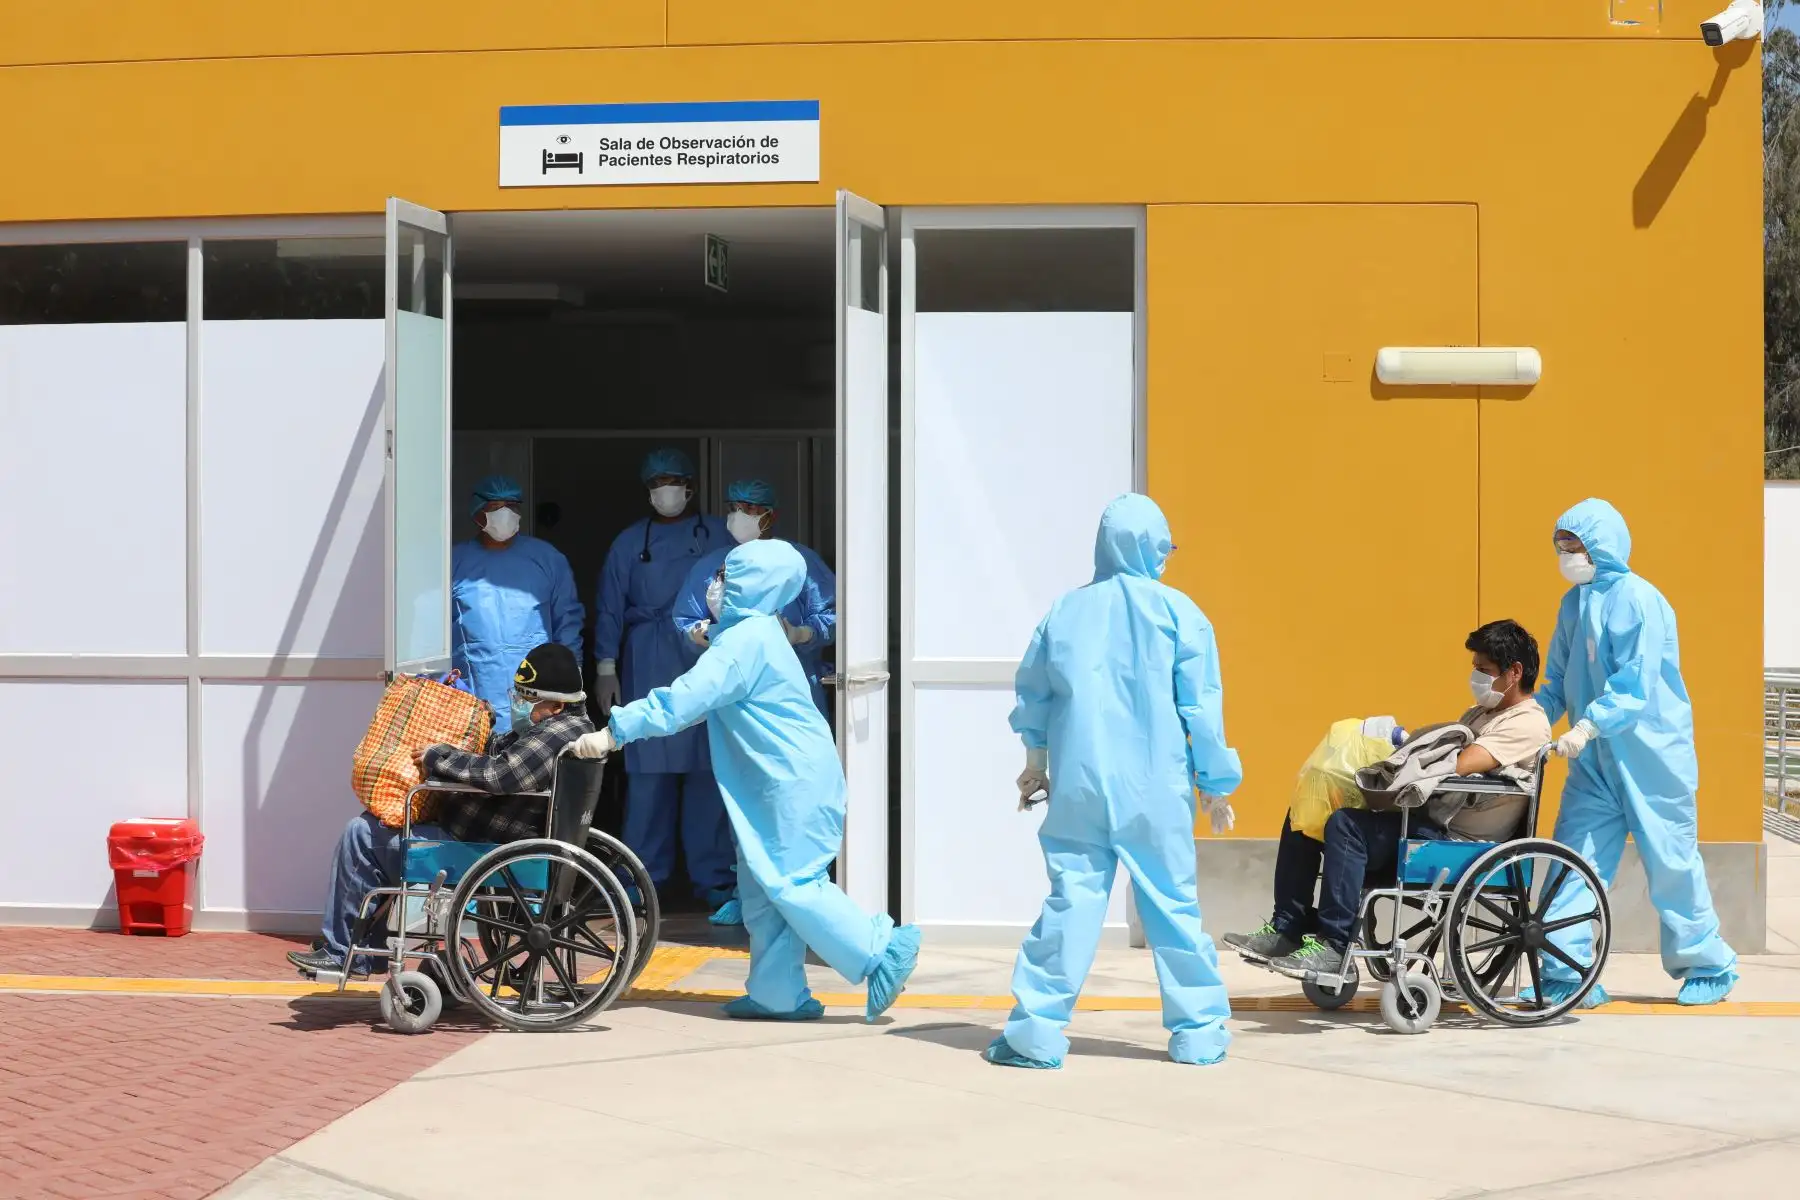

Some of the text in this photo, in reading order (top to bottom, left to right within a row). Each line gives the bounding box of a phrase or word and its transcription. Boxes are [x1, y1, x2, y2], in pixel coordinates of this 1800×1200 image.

[599, 135, 779, 150] Sala de Observación de
[598, 152, 780, 167] Pacientes Respiratorios
